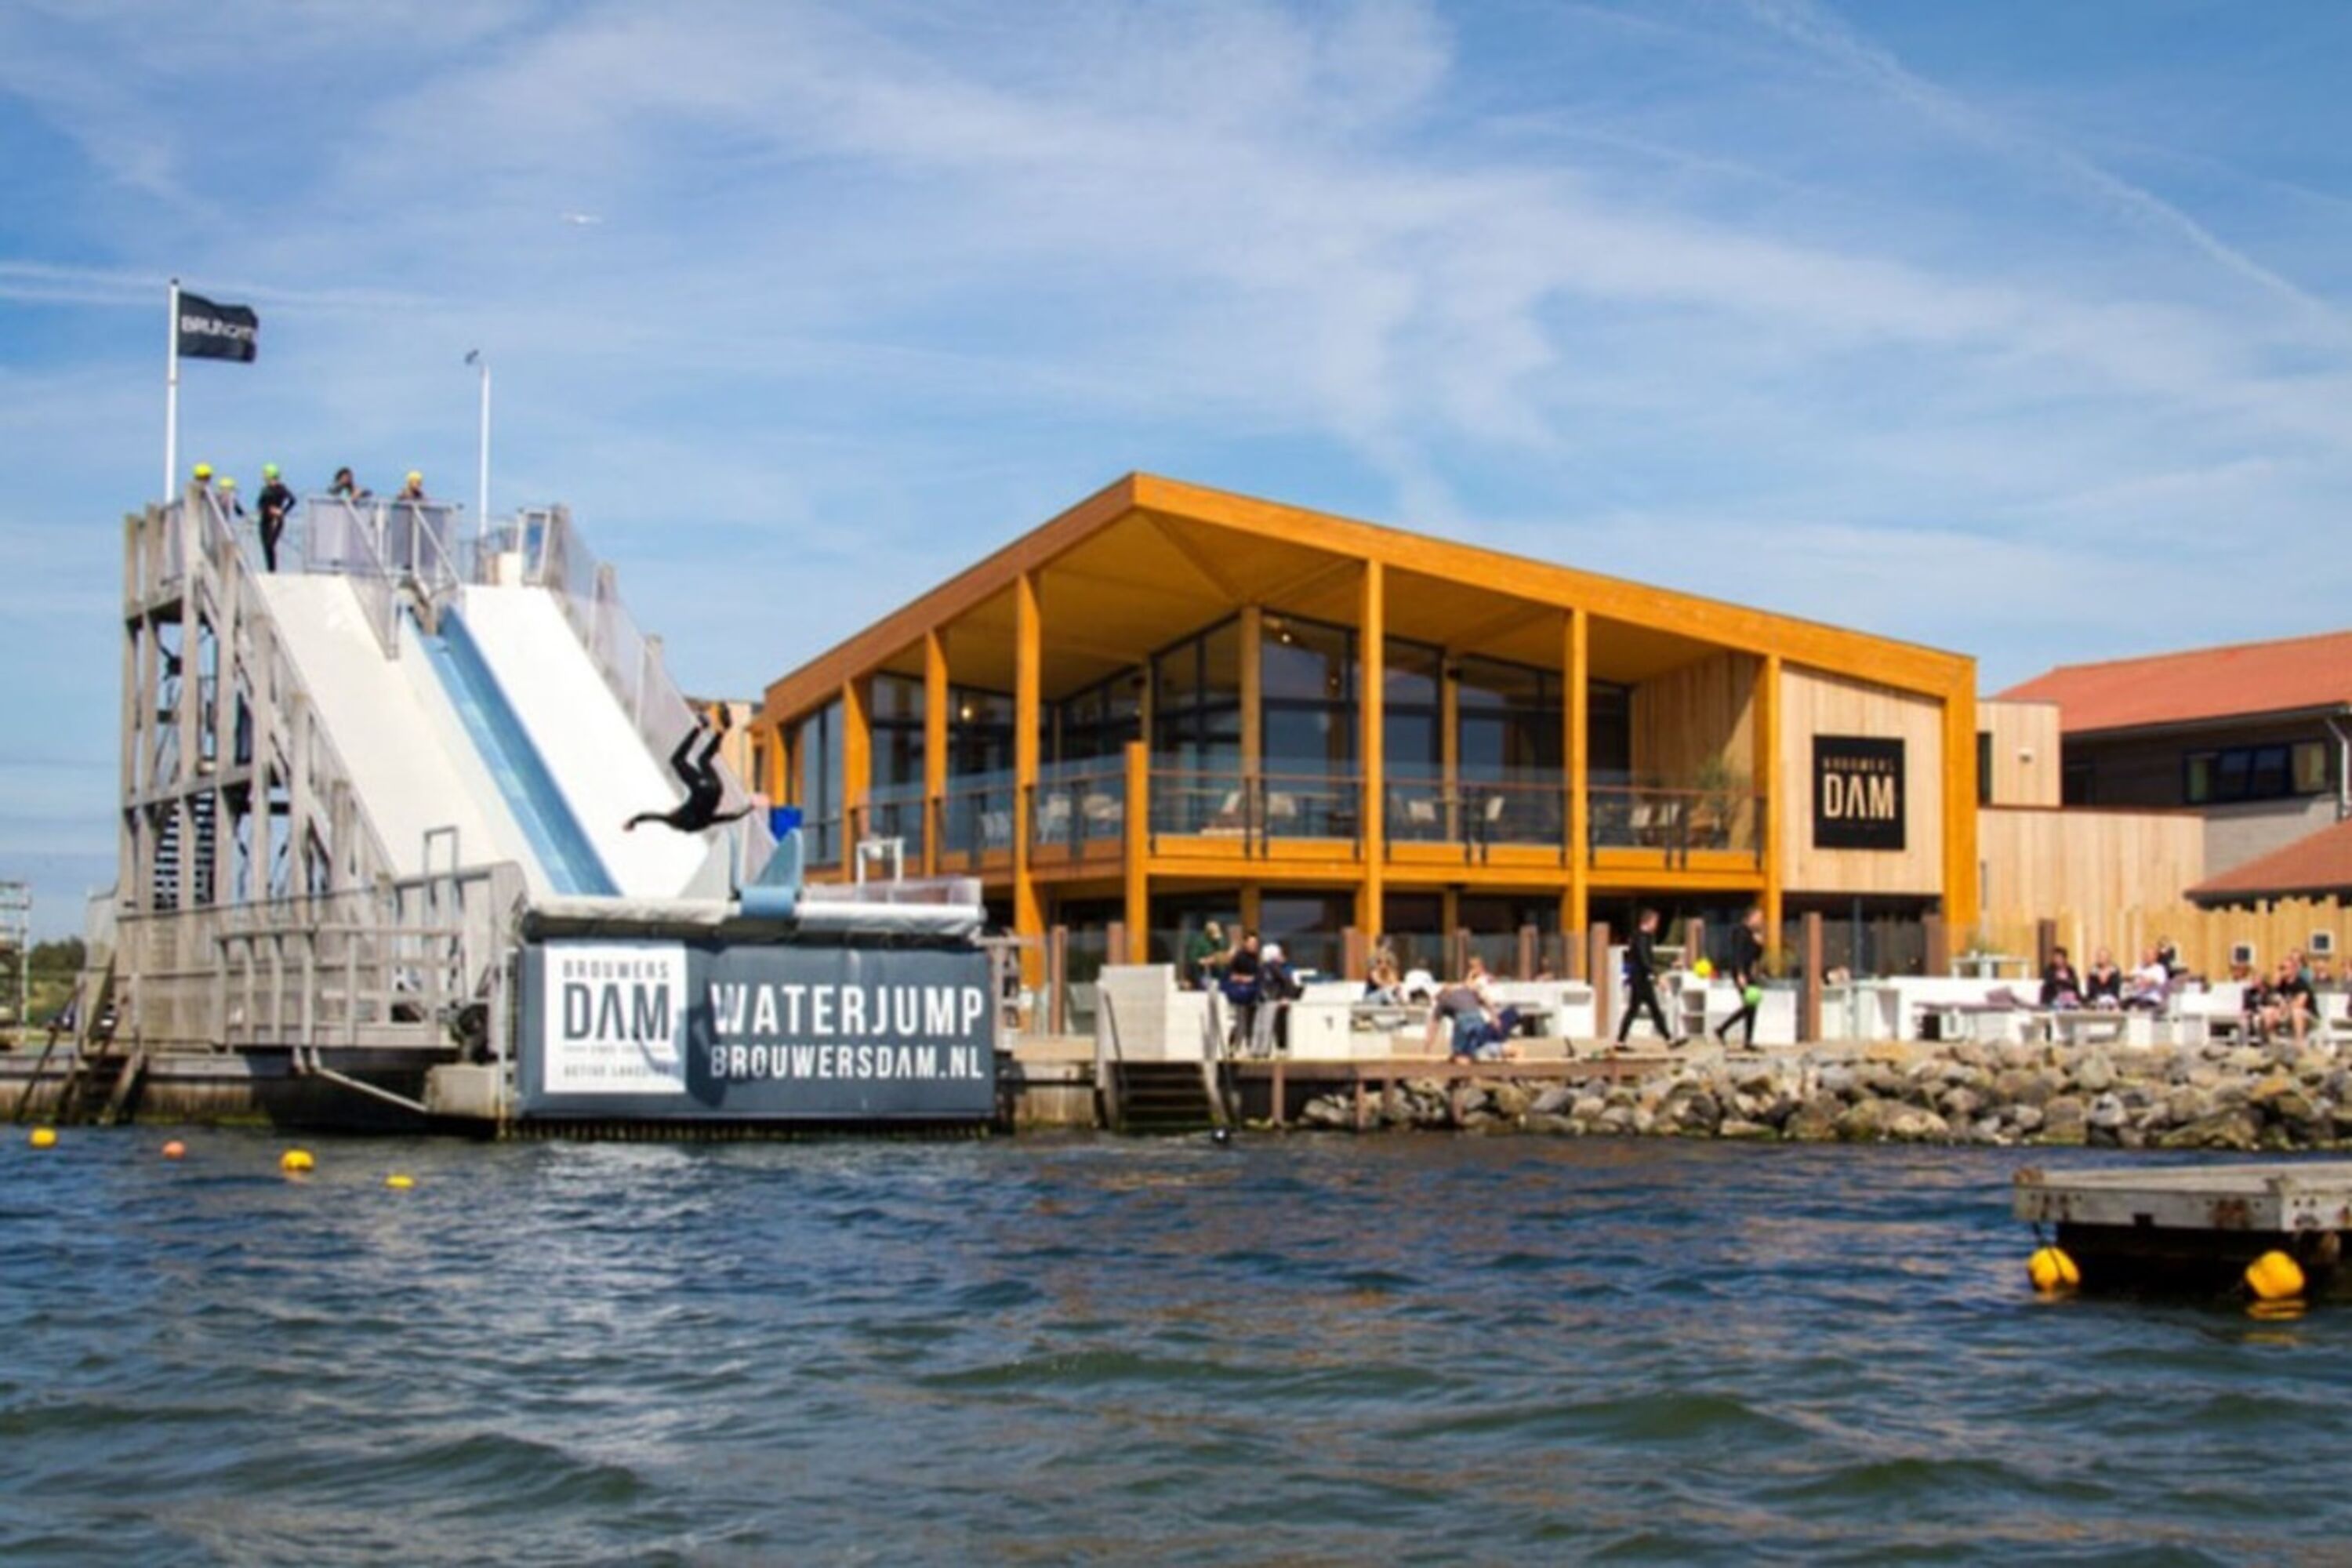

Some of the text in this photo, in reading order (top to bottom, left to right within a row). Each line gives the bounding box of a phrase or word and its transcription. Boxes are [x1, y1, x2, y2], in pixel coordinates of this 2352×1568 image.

[1824, 773, 1894, 819] DAM
[564, 959, 669, 978] BROUWERS
[564, 982, 670, 1040] DAM
[710, 983, 984, 1036] WATERJUMP
[710, 1044, 985, 1079] BROUWERSDAM.NL
